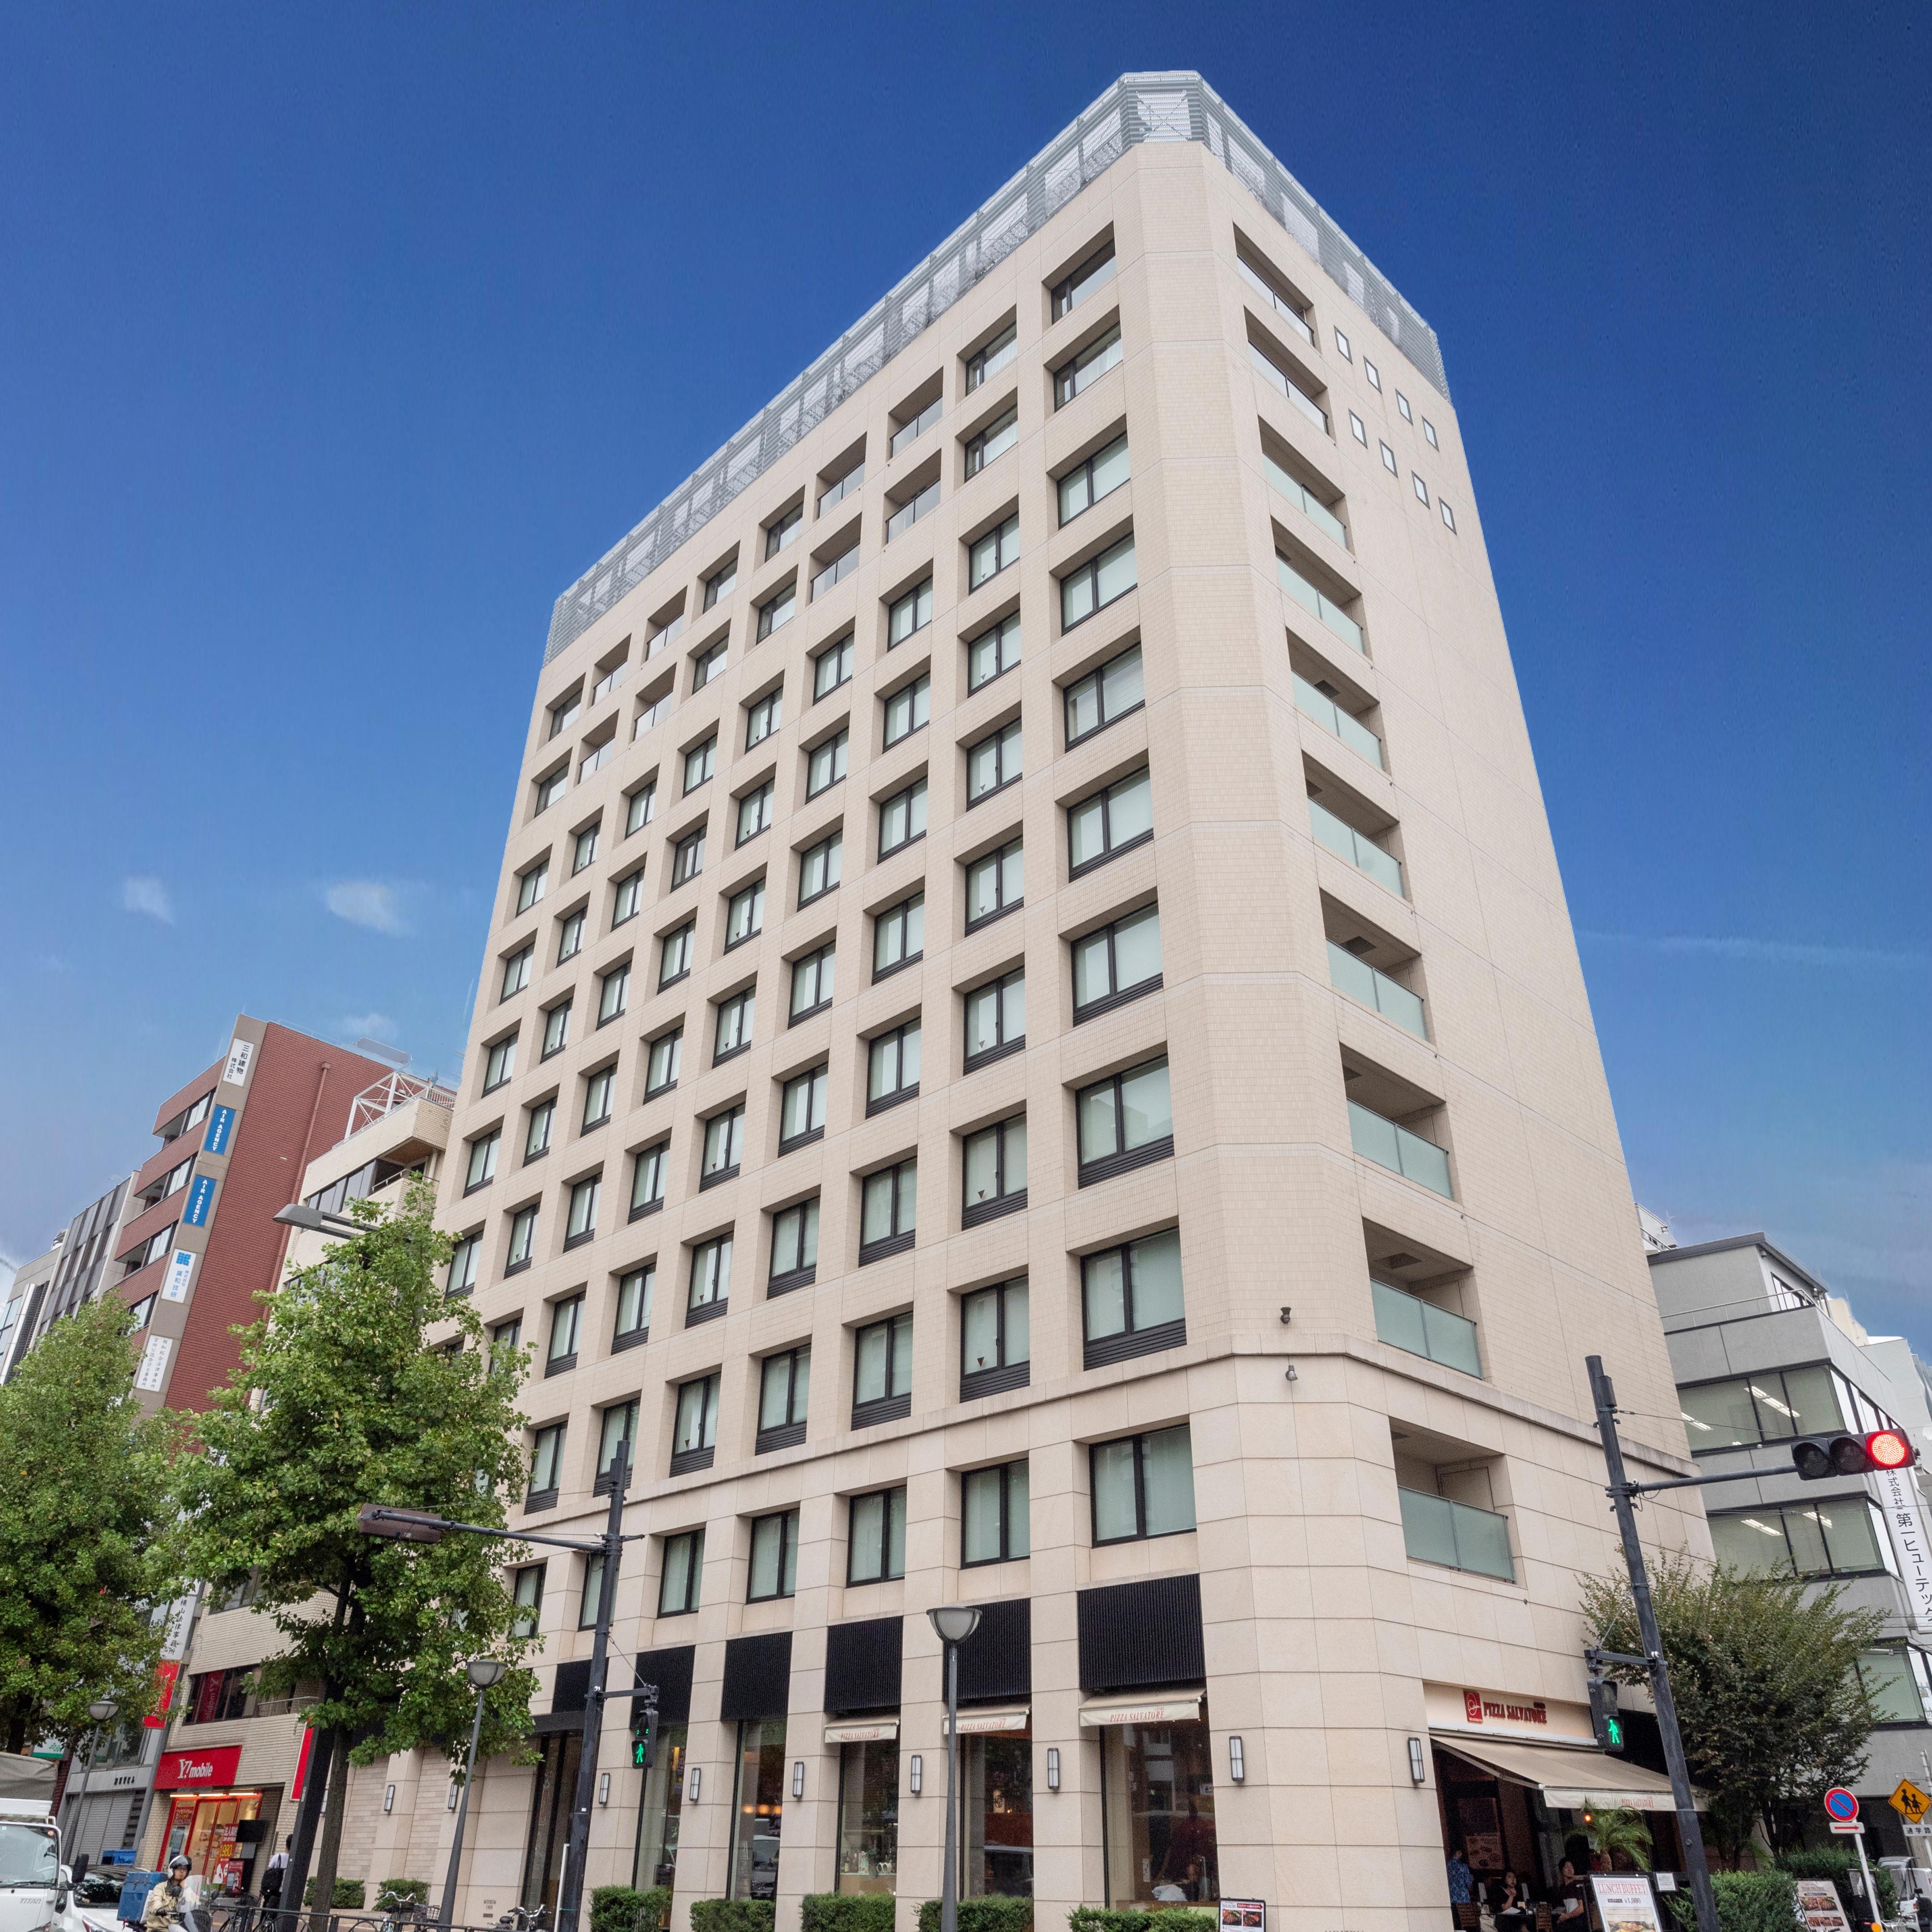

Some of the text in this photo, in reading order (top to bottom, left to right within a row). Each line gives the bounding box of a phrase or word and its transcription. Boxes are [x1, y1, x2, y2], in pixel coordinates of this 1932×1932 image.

[226, 1057, 237, 1079] 株式会社
[236, 1045, 250, 1075] 三和建物
[212, 1124, 223, 1151] AGENCY
[193, 1195, 203, 1224] AGENCY
[1886, 1469, 1905, 1510] 株式会社
[1110, 1710, 1164, 1722] PIZZA SALVATORE
[1483, 1701, 1547, 1724] PIZZA SALVATORE
[855, 1730, 879, 1739] SALVATORE
[961, 1720, 1007, 1732] PIZZA SALVATORE
[177, 1759, 213, 1779] Y!mobile
[1621, 1798, 1654, 1808] PIZZA SALVATORE
[1597, 1883, 1646, 1895] LUNCH BUFFET
